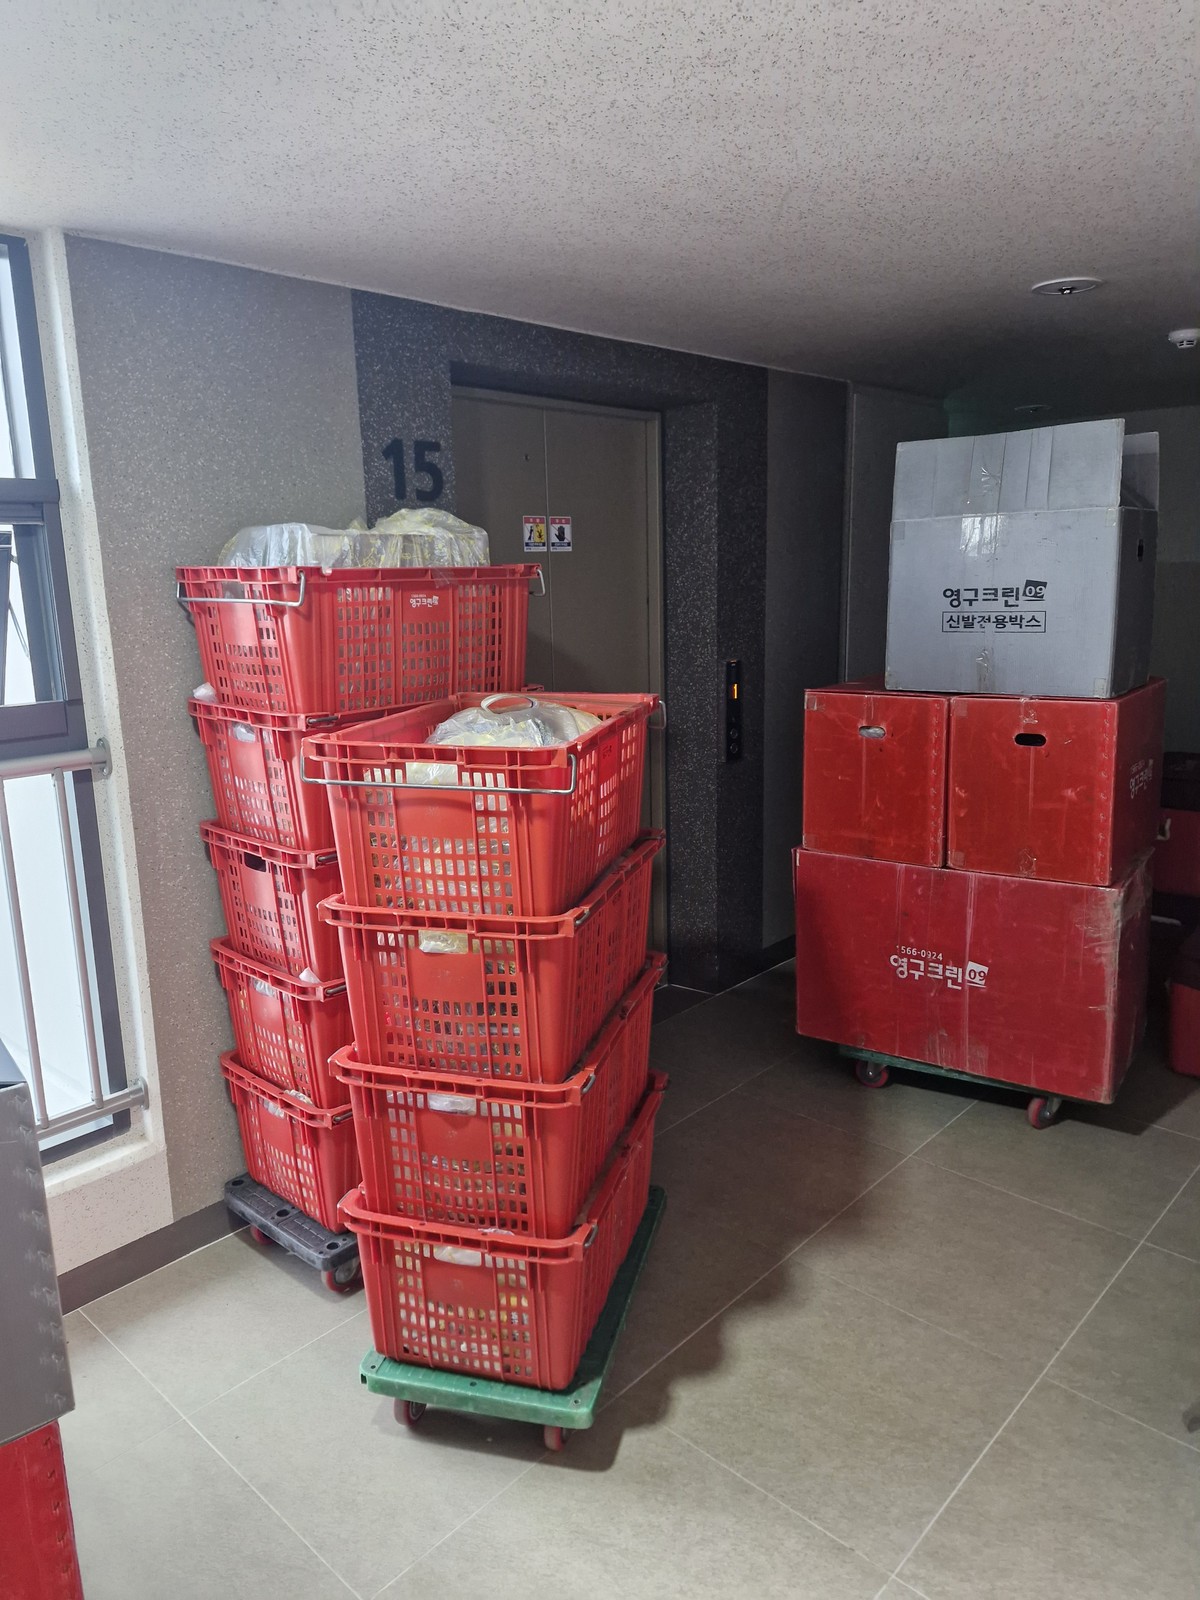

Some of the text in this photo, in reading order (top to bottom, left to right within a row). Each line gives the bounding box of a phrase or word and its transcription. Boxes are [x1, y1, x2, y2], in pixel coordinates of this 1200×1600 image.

[382, 438, 443, 501] 15
[943, 587, 1020, 608] 영구크린
[946, 614, 1042, 629] 신발전용박스
[896, 945, 943, 961] 566-0924
[890, 955, 962, 990] 영구크린
